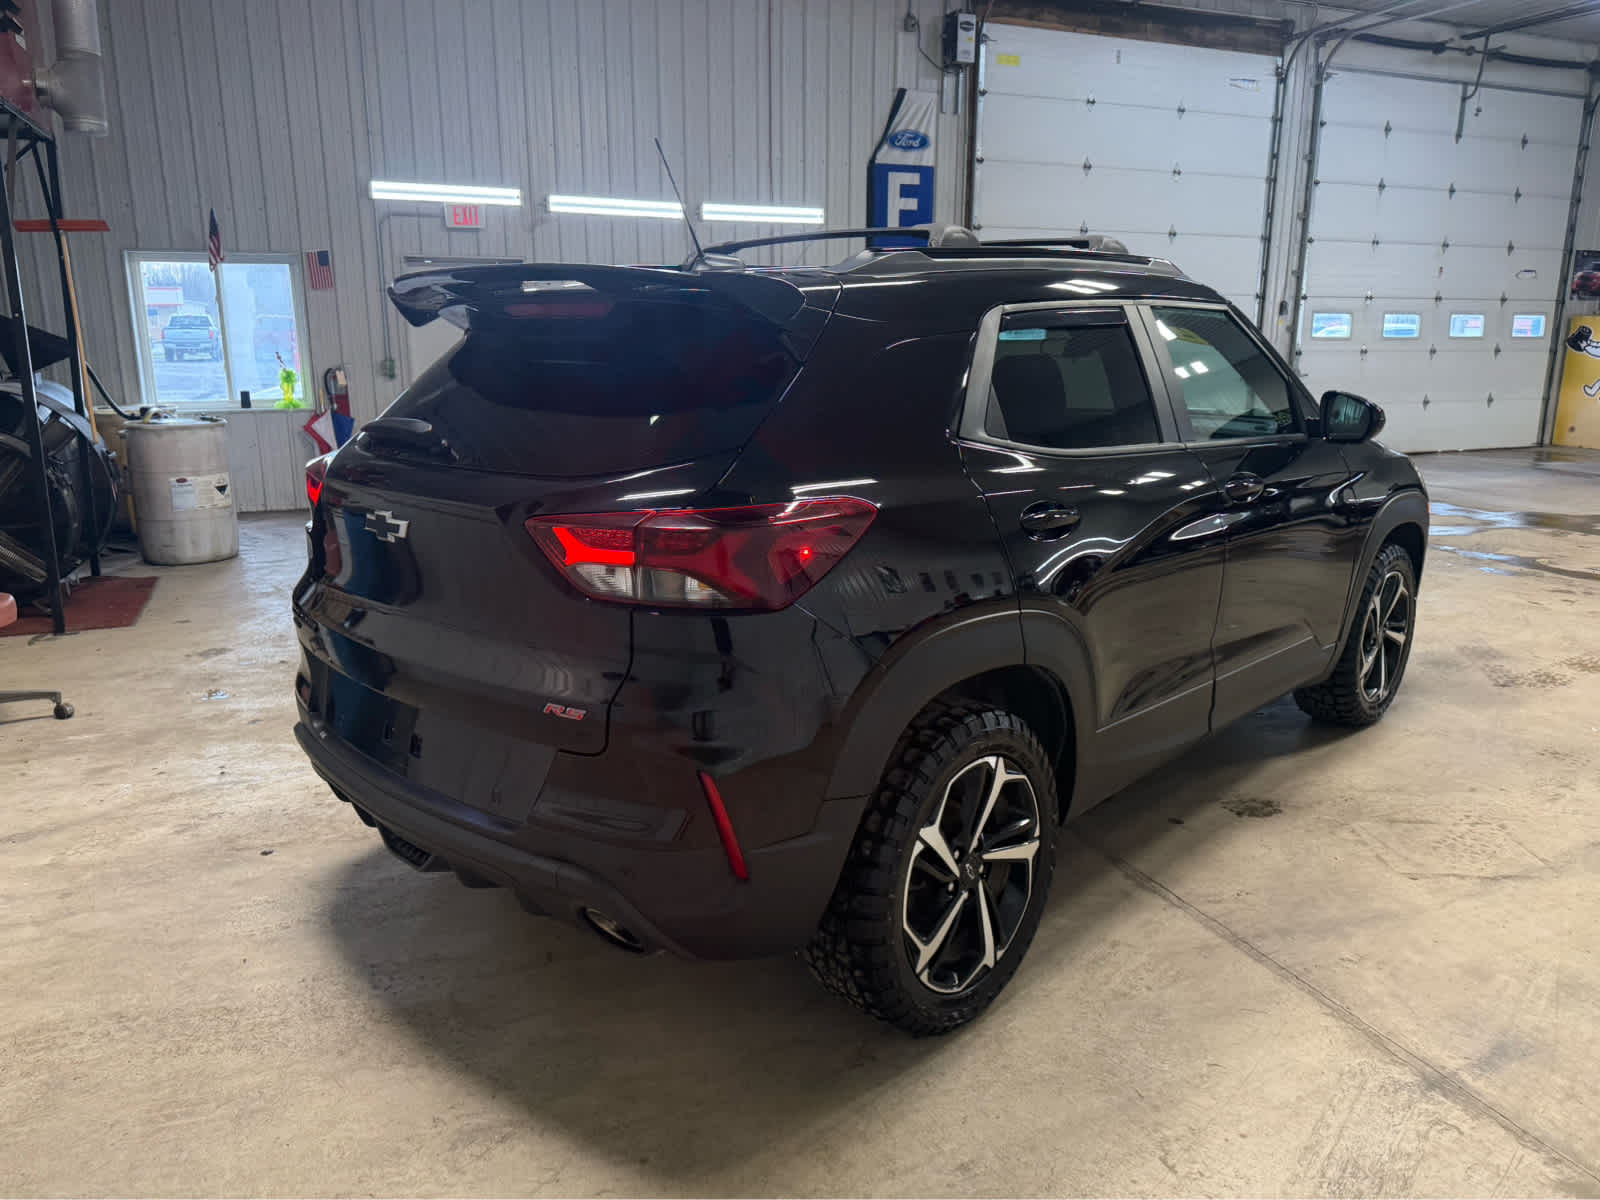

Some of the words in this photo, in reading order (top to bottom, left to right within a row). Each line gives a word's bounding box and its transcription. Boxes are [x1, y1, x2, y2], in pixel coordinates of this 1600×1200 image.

[895, 132, 921, 147] Ford
[887, 171, 920, 228] F
[453, 205, 480, 226] EXIT
[543, 703, 587, 721] RS
